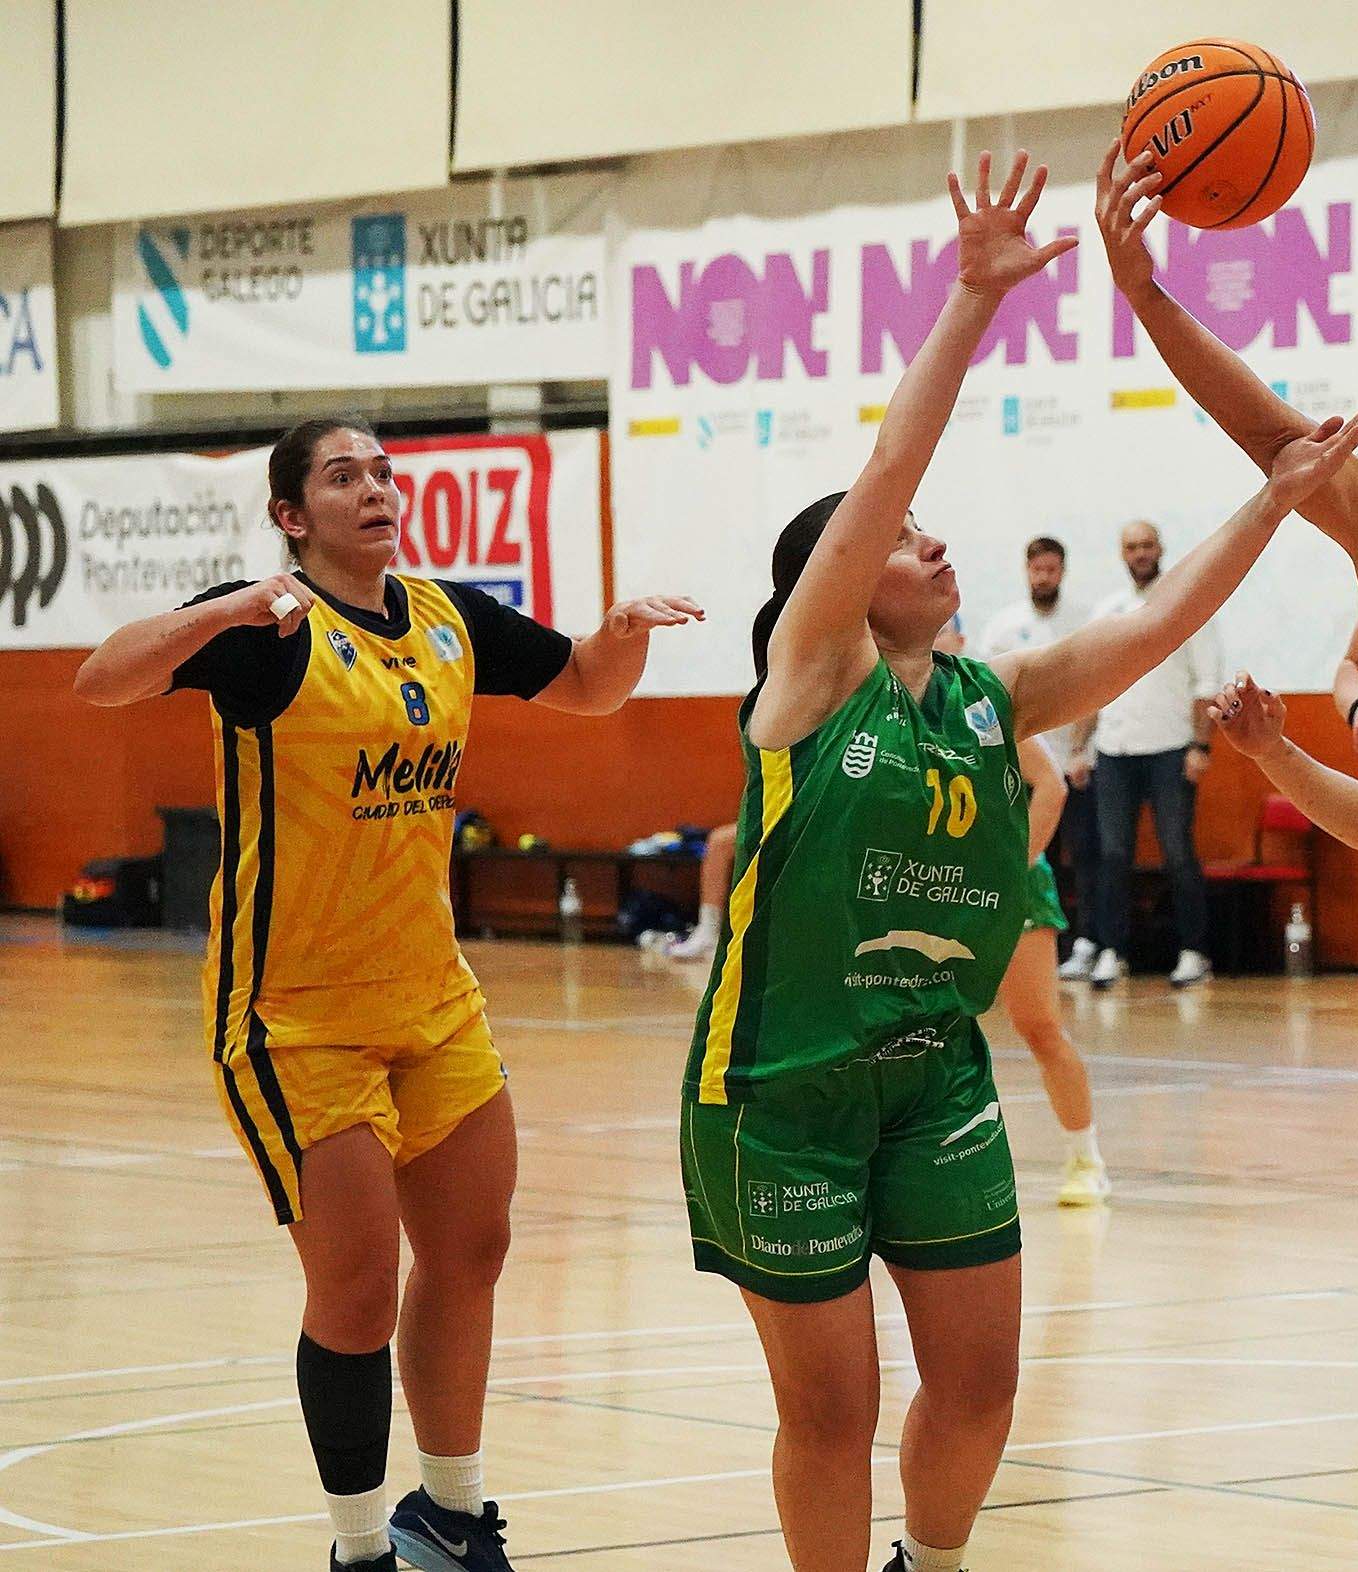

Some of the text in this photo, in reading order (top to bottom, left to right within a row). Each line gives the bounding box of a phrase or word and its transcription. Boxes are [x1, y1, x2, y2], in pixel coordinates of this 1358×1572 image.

[1127, 56, 1204, 107] lson
[1151, 108, 1192, 158] VO
[201, 217, 314, 259] DEPORTE
[418, 215, 528, 265] XUNTA
[202, 264, 302, 302] GALEGO
[418, 271, 597, 328] DE GALICIA
[388, 468, 521, 569] ROIZ
[400, 681, 430, 726] 8
[403, 800, 427, 816] DEL
[428, 796, 456, 811] DEPO
[926, 768, 977, 838] 10
[903, 859, 964, 883] XUNTA
[896, 878, 1000, 909] DE GALICIA
[782, 1182, 829, 1199] XUNTA
[783, 1191, 858, 1212] DE GALICIA
